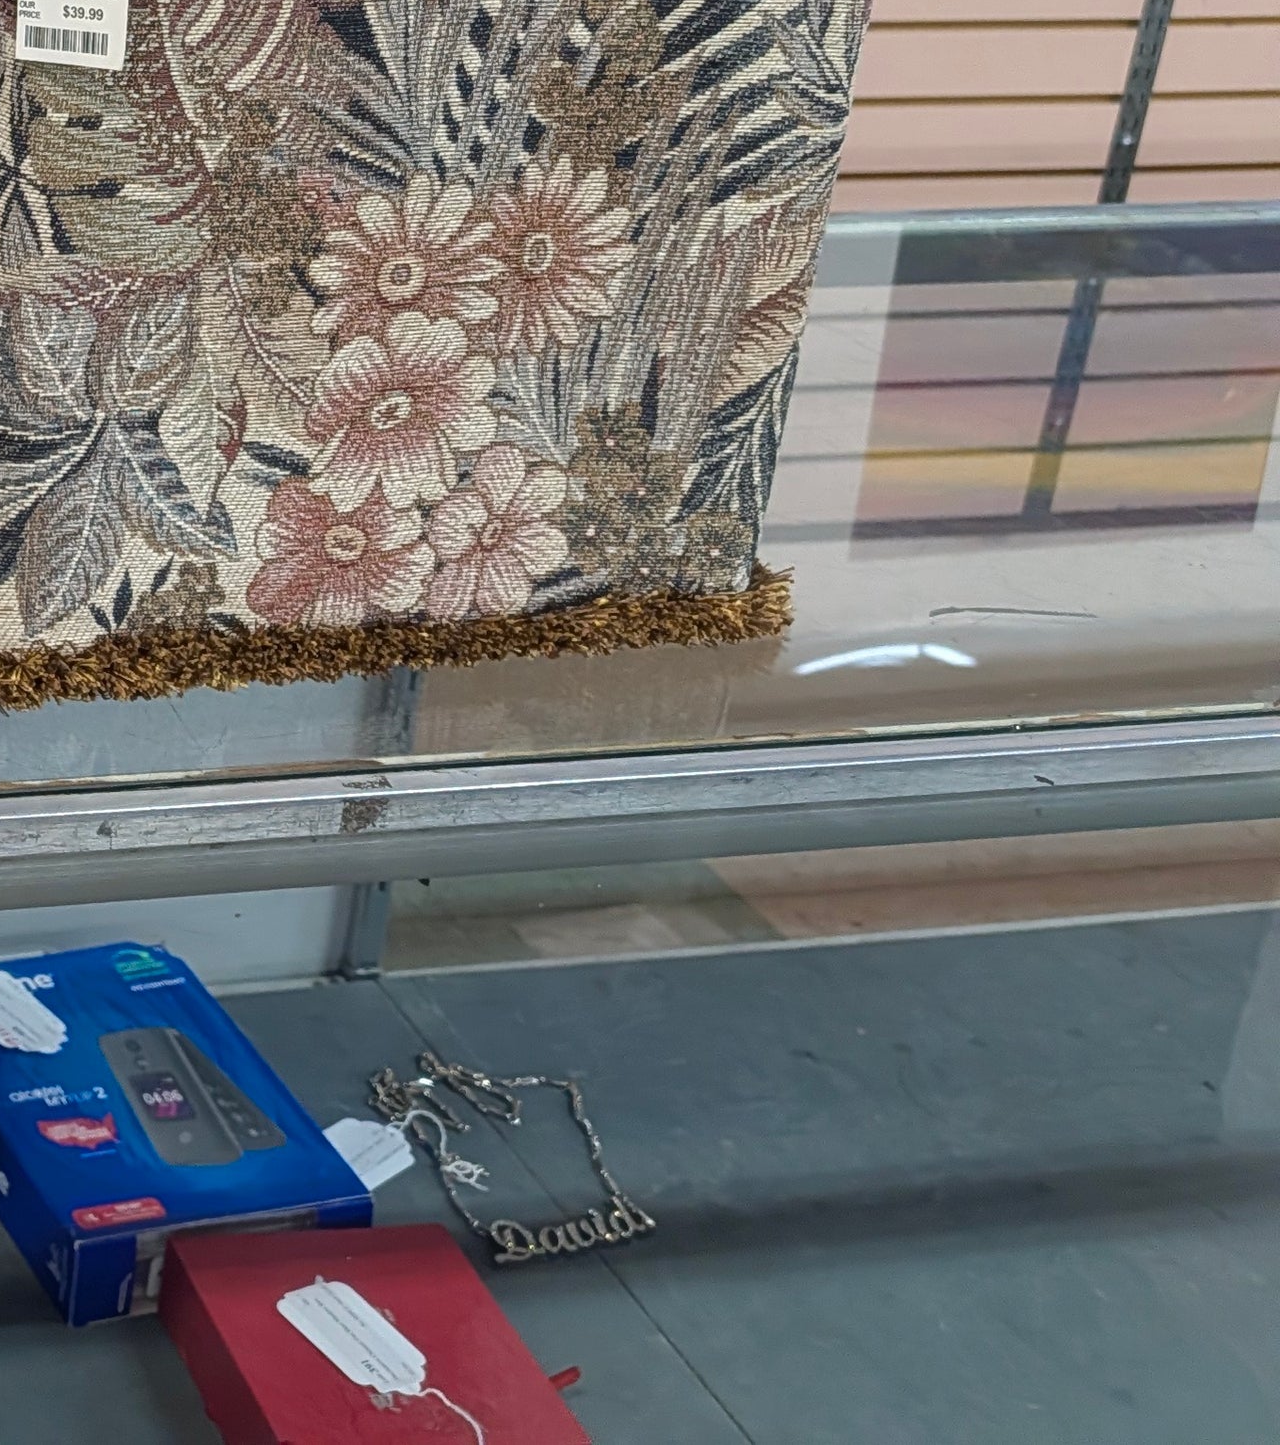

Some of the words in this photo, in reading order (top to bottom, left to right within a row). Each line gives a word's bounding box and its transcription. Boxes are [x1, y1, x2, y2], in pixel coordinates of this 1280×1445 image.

[19, 0, 35, 9] OUR
[19, 9, 41, 19] PRICE
[62, 4, 104, 21] $39.99
[489, 1195, 653, 1264] David
